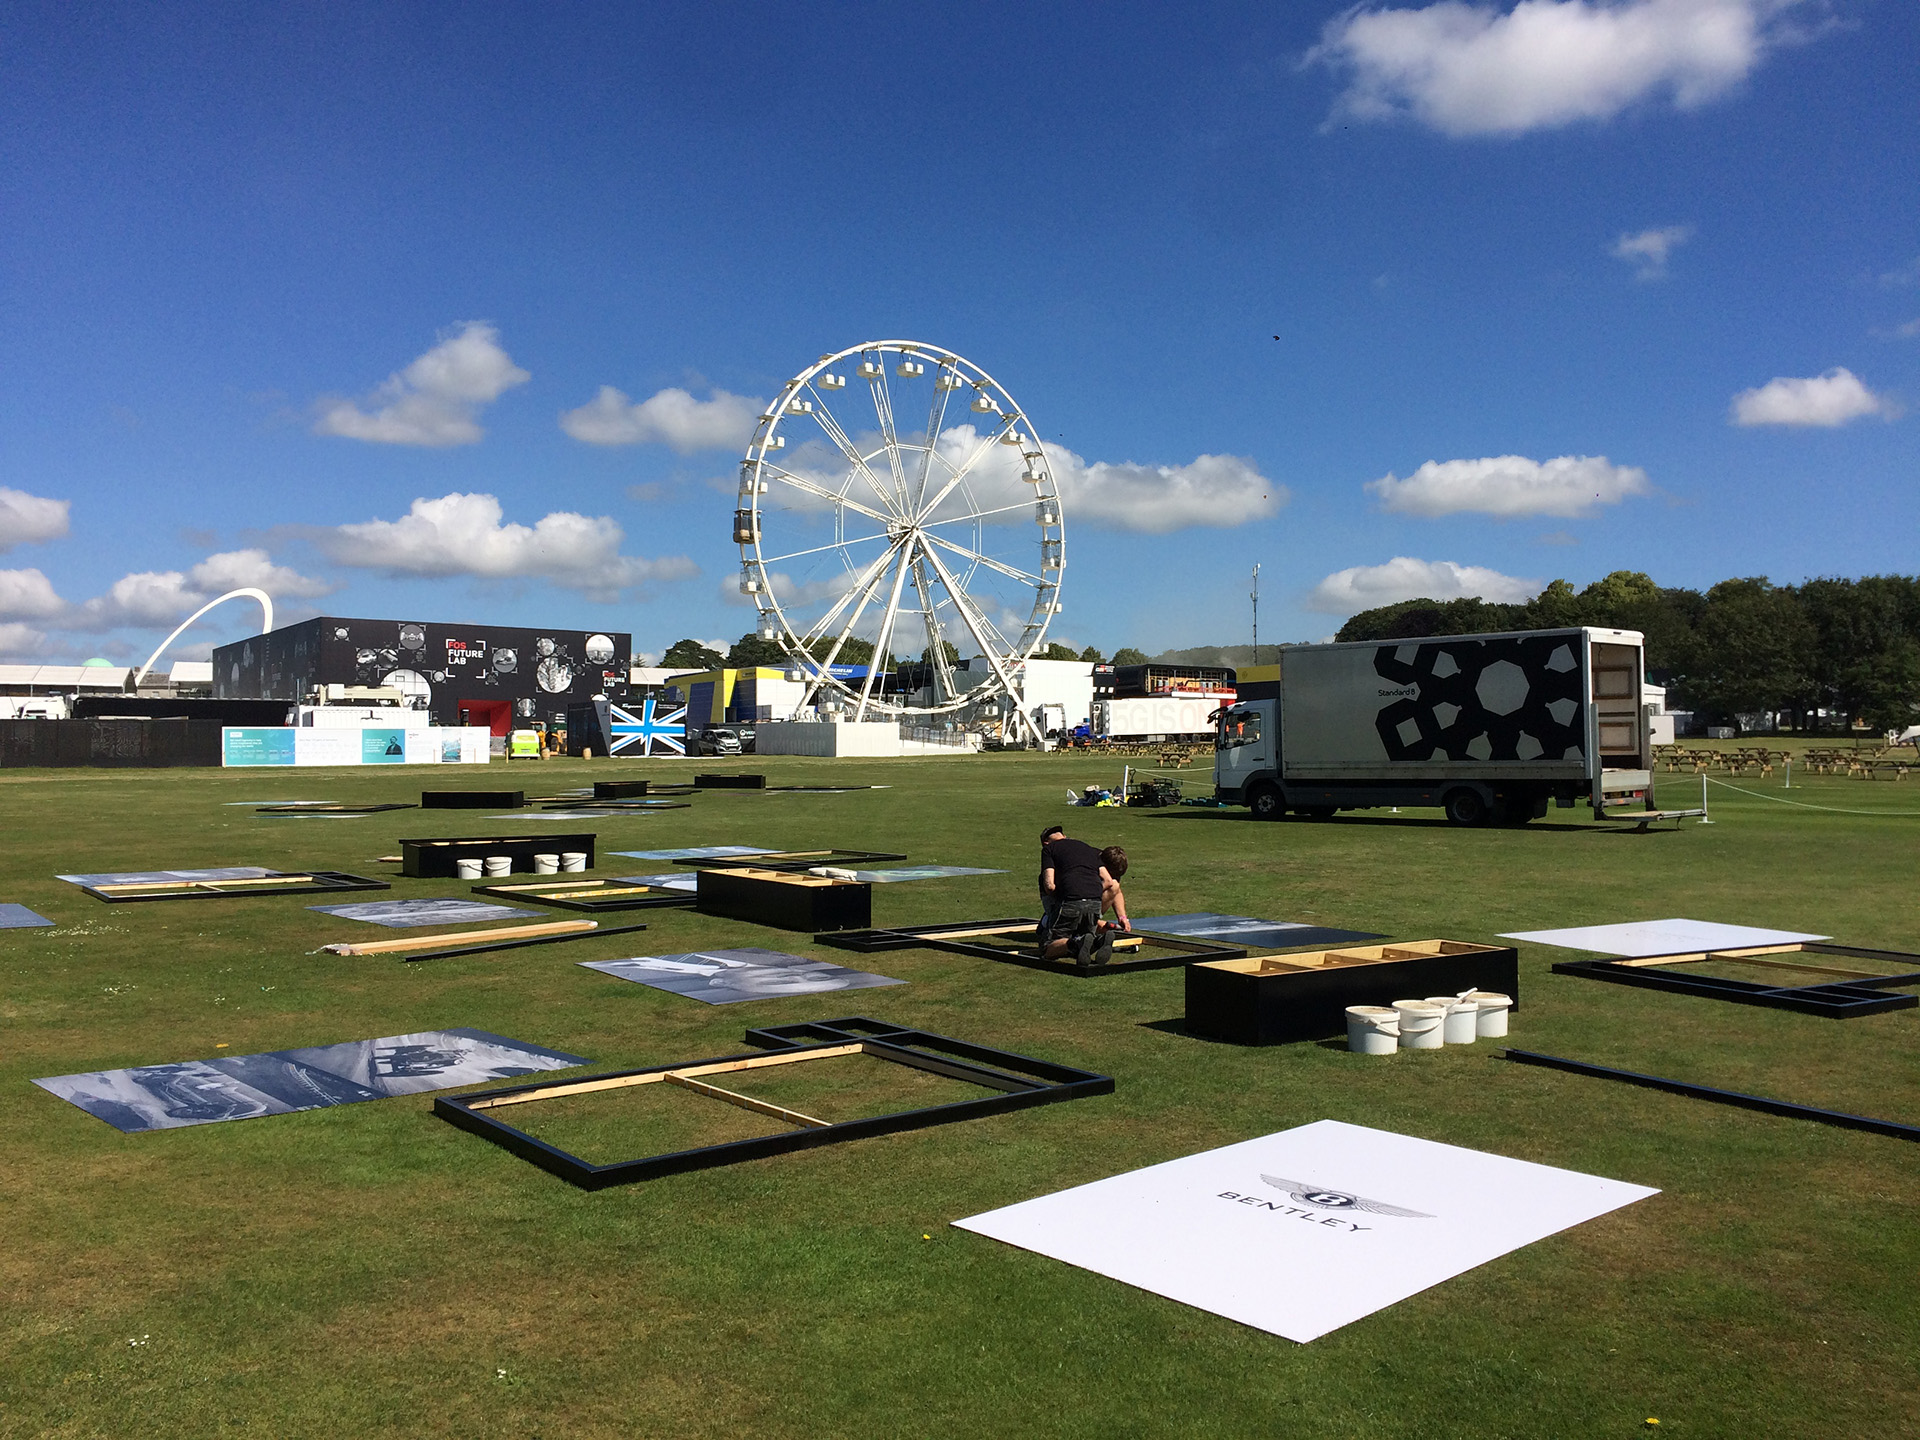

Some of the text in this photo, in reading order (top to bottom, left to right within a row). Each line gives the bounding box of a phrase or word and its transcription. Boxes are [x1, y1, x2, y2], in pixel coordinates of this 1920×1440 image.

[448, 641, 467, 649] FOS
[448, 649, 484, 658] FUTURE
[448, 657, 467, 665] LAB
[1378, 688, 1410, 697] Standard
[1217, 1191, 1373, 1232] BENTLEY
